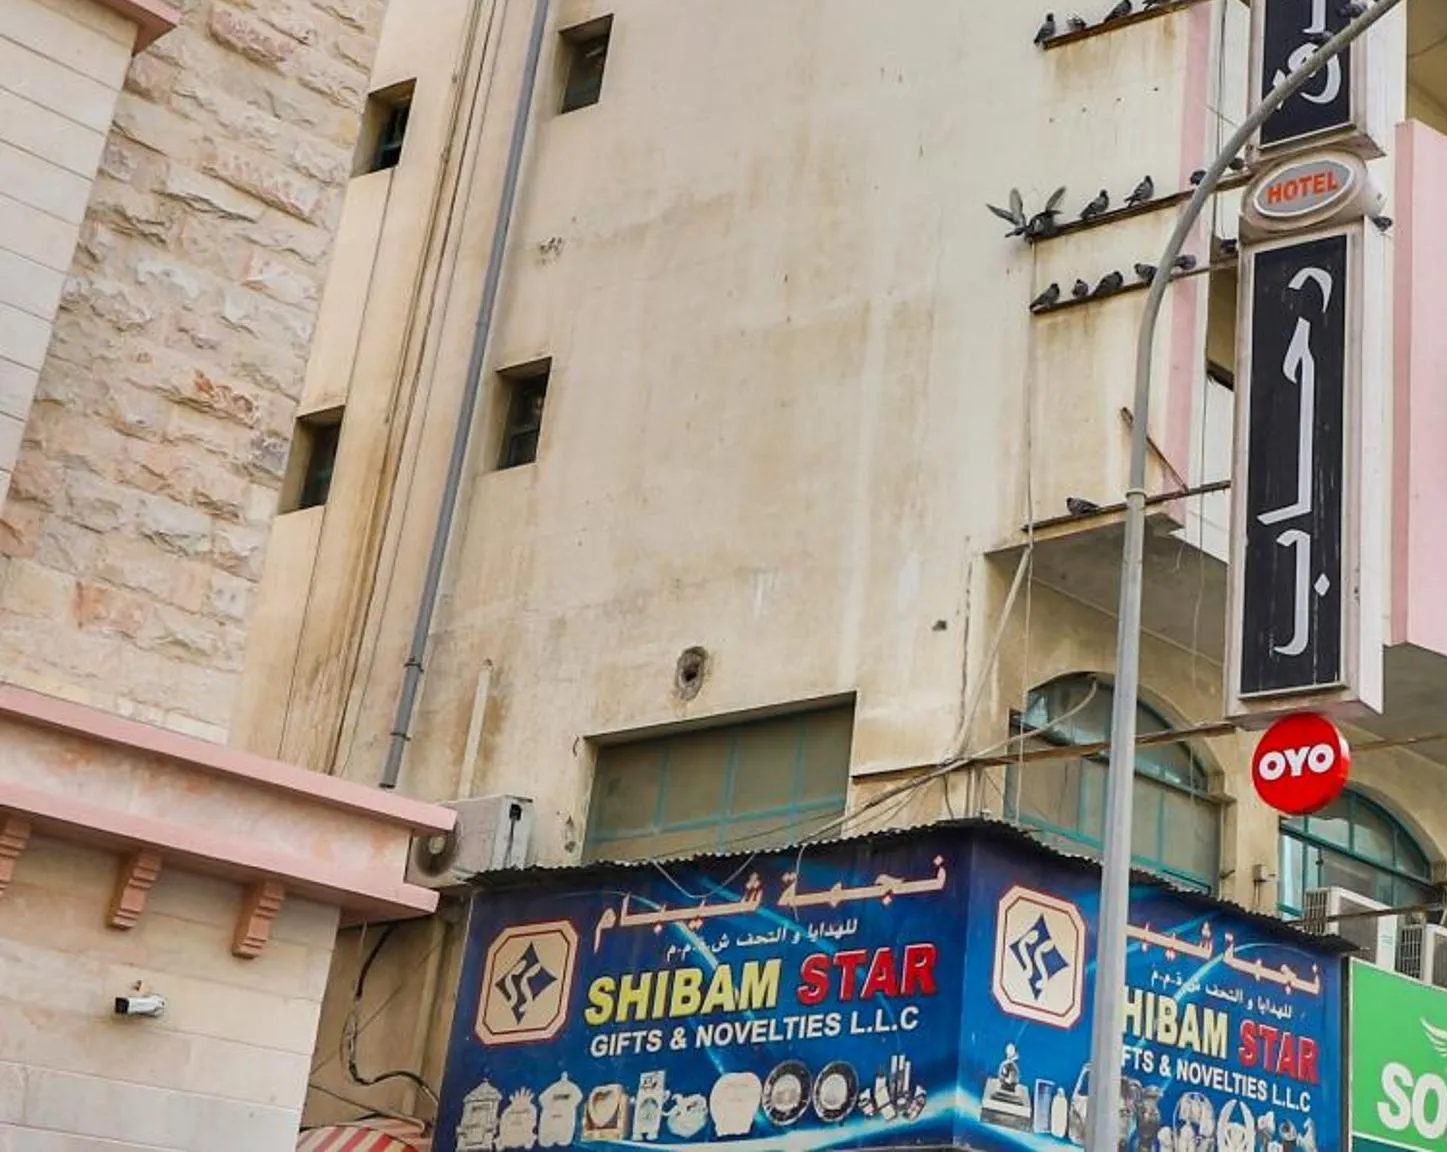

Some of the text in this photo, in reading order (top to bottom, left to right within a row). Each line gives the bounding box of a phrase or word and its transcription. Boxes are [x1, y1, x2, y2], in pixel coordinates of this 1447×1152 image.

[1266, 170, 1338, 204] HOTEL
[1259, 743, 1335, 781] OYO
[593, 854, 947, 954] نجمة شيبام
[736, 924, 787, 947] التحف
[584, 943, 939, 1026] SHIBAM STAR
[1223, 931, 1321, 995] نجمة
[590, 1006, 920, 1058] GIFTS & NOVELTIES L.L.C
[1123, 986, 1320, 1085] HIBAM STAR
[1121, 1045, 1312, 1112] FTS & NOVELTIES L.L.C
